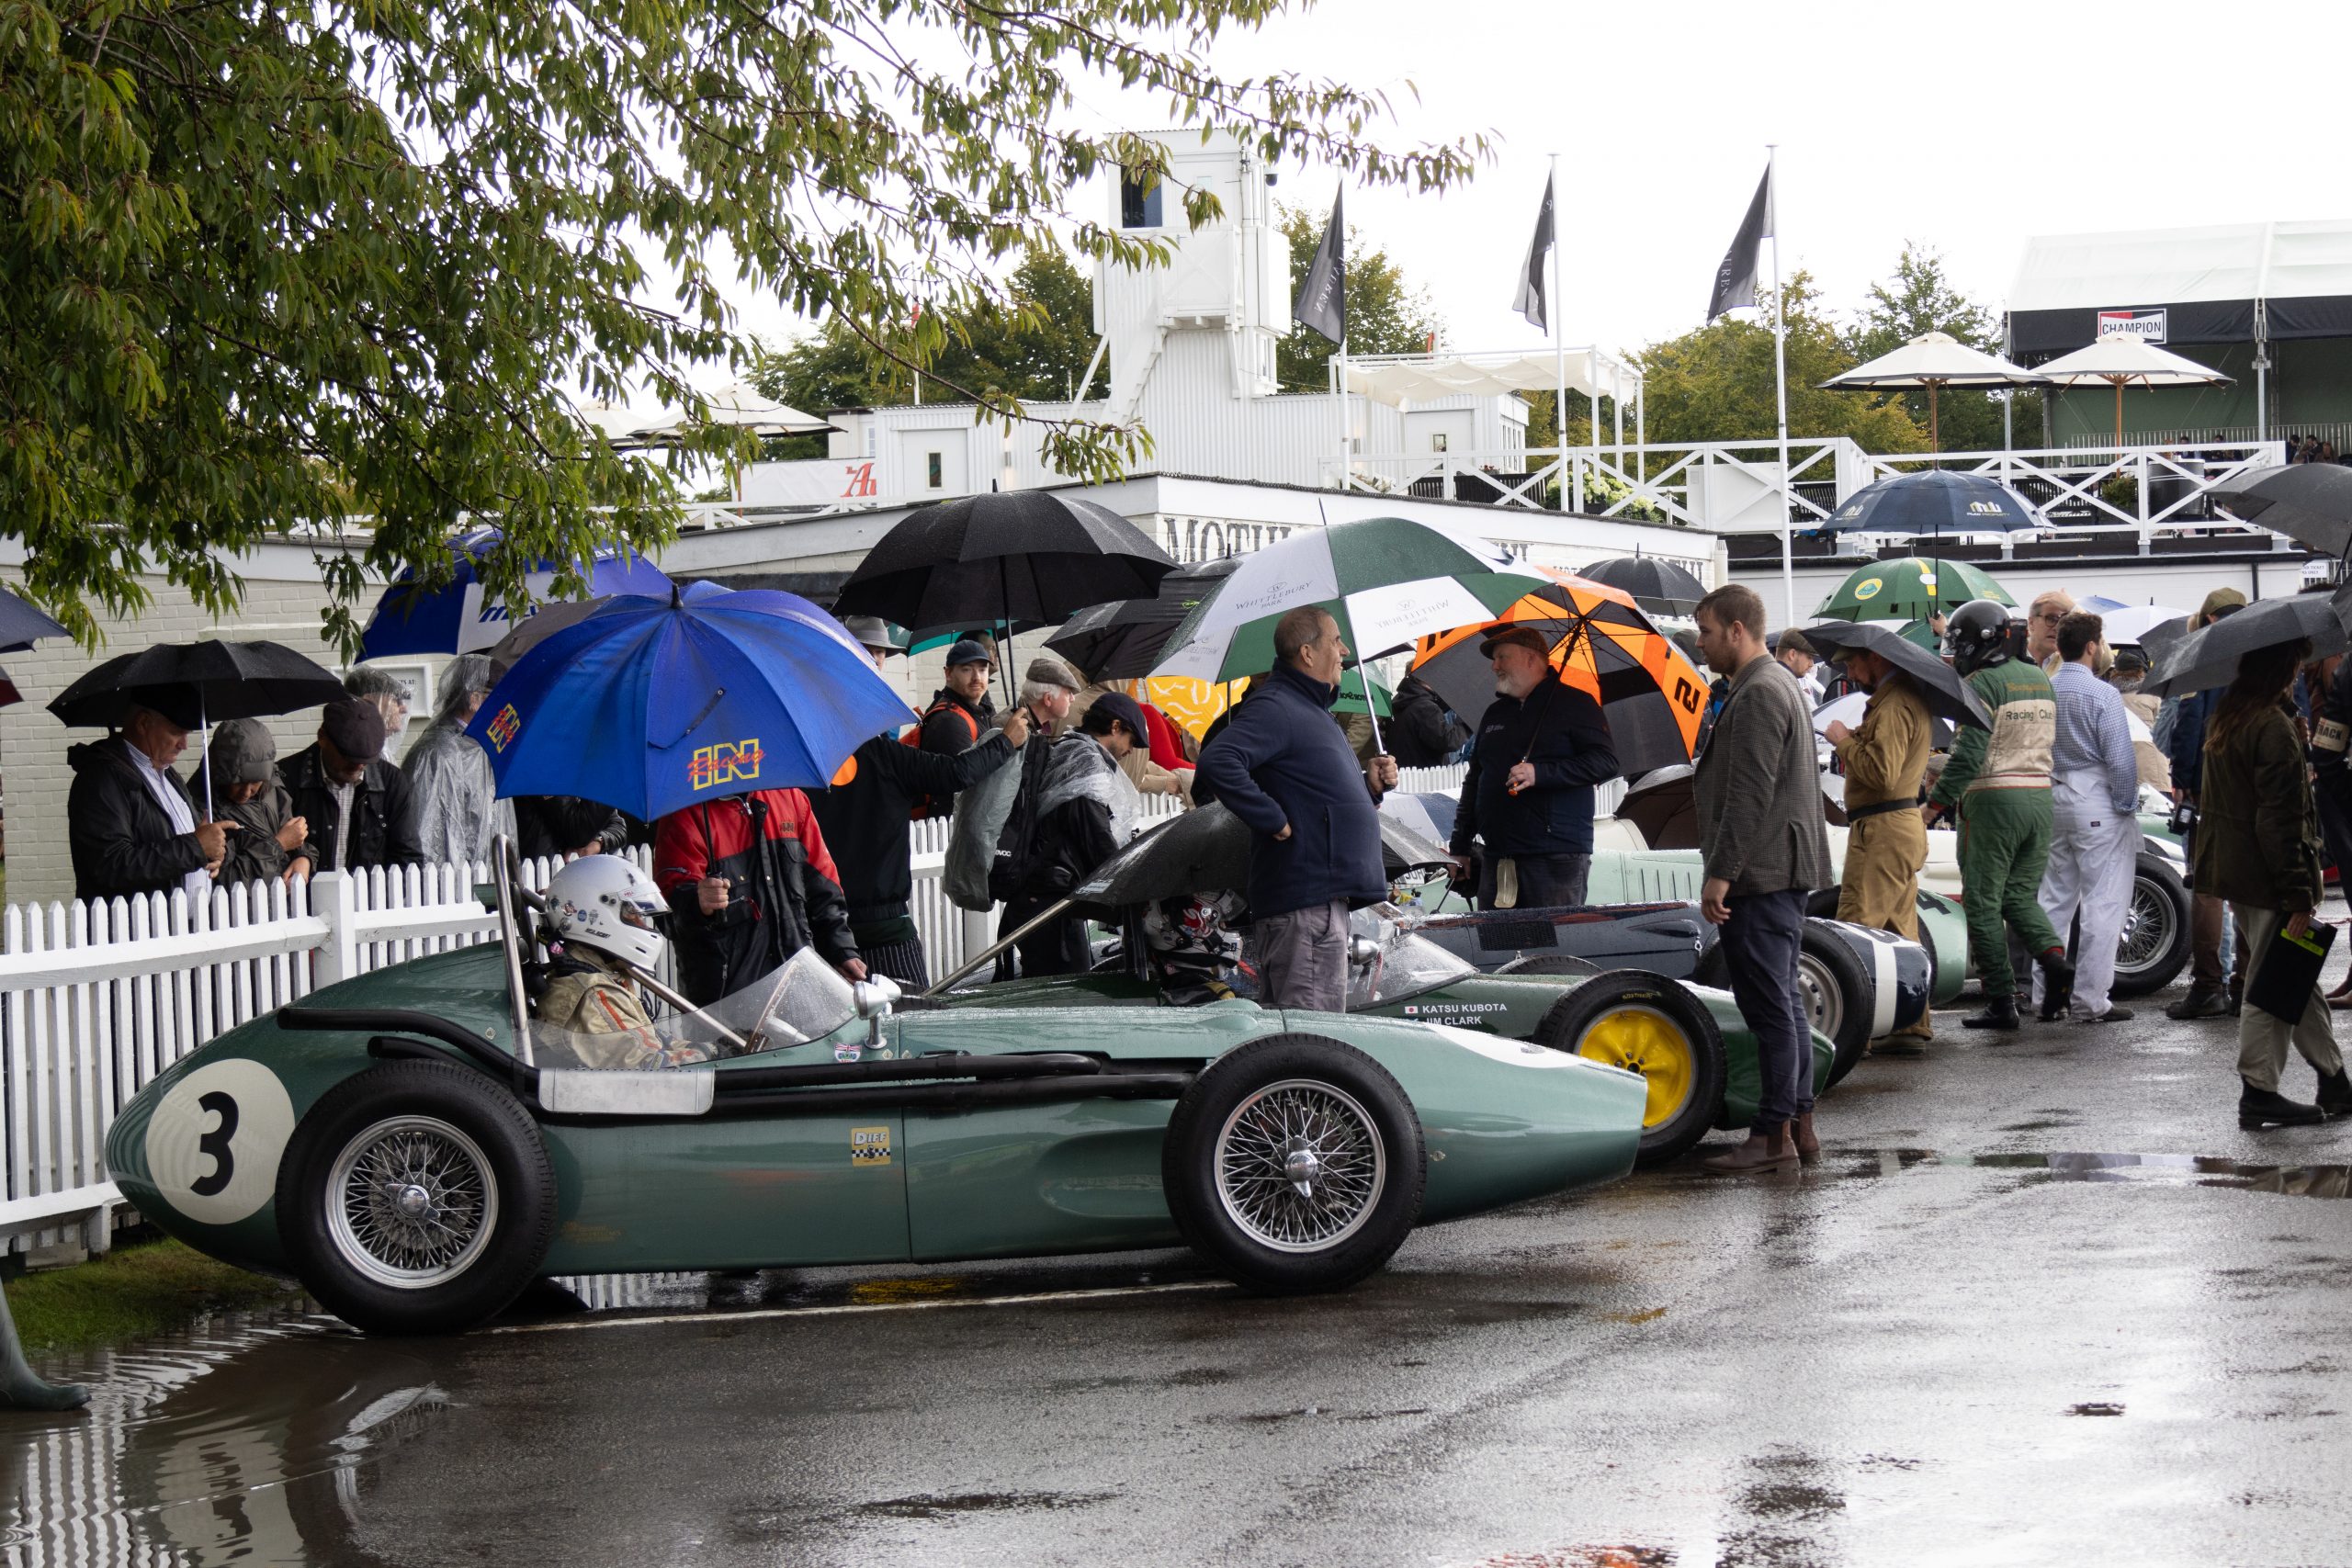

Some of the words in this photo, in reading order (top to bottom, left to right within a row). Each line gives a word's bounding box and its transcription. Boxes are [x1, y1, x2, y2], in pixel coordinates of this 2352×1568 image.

[2102, 321, 2162, 335] CHAMPION
[1235, 580, 1314, 610] WHITTLEBURY
[1261, 598, 1283, 609] PARK
[2006, 708, 2034, 721] Racing
[686, 749, 766, 783] Racing
[1422, 1004, 1459, 1014] KATSU
[1462, 1003, 1507, 1012] KUBOTA
[1444, 1016, 1482, 1025] CLARK
[189, 1090, 239, 1197] 3
[854, 1132, 887, 1145] DIFF
